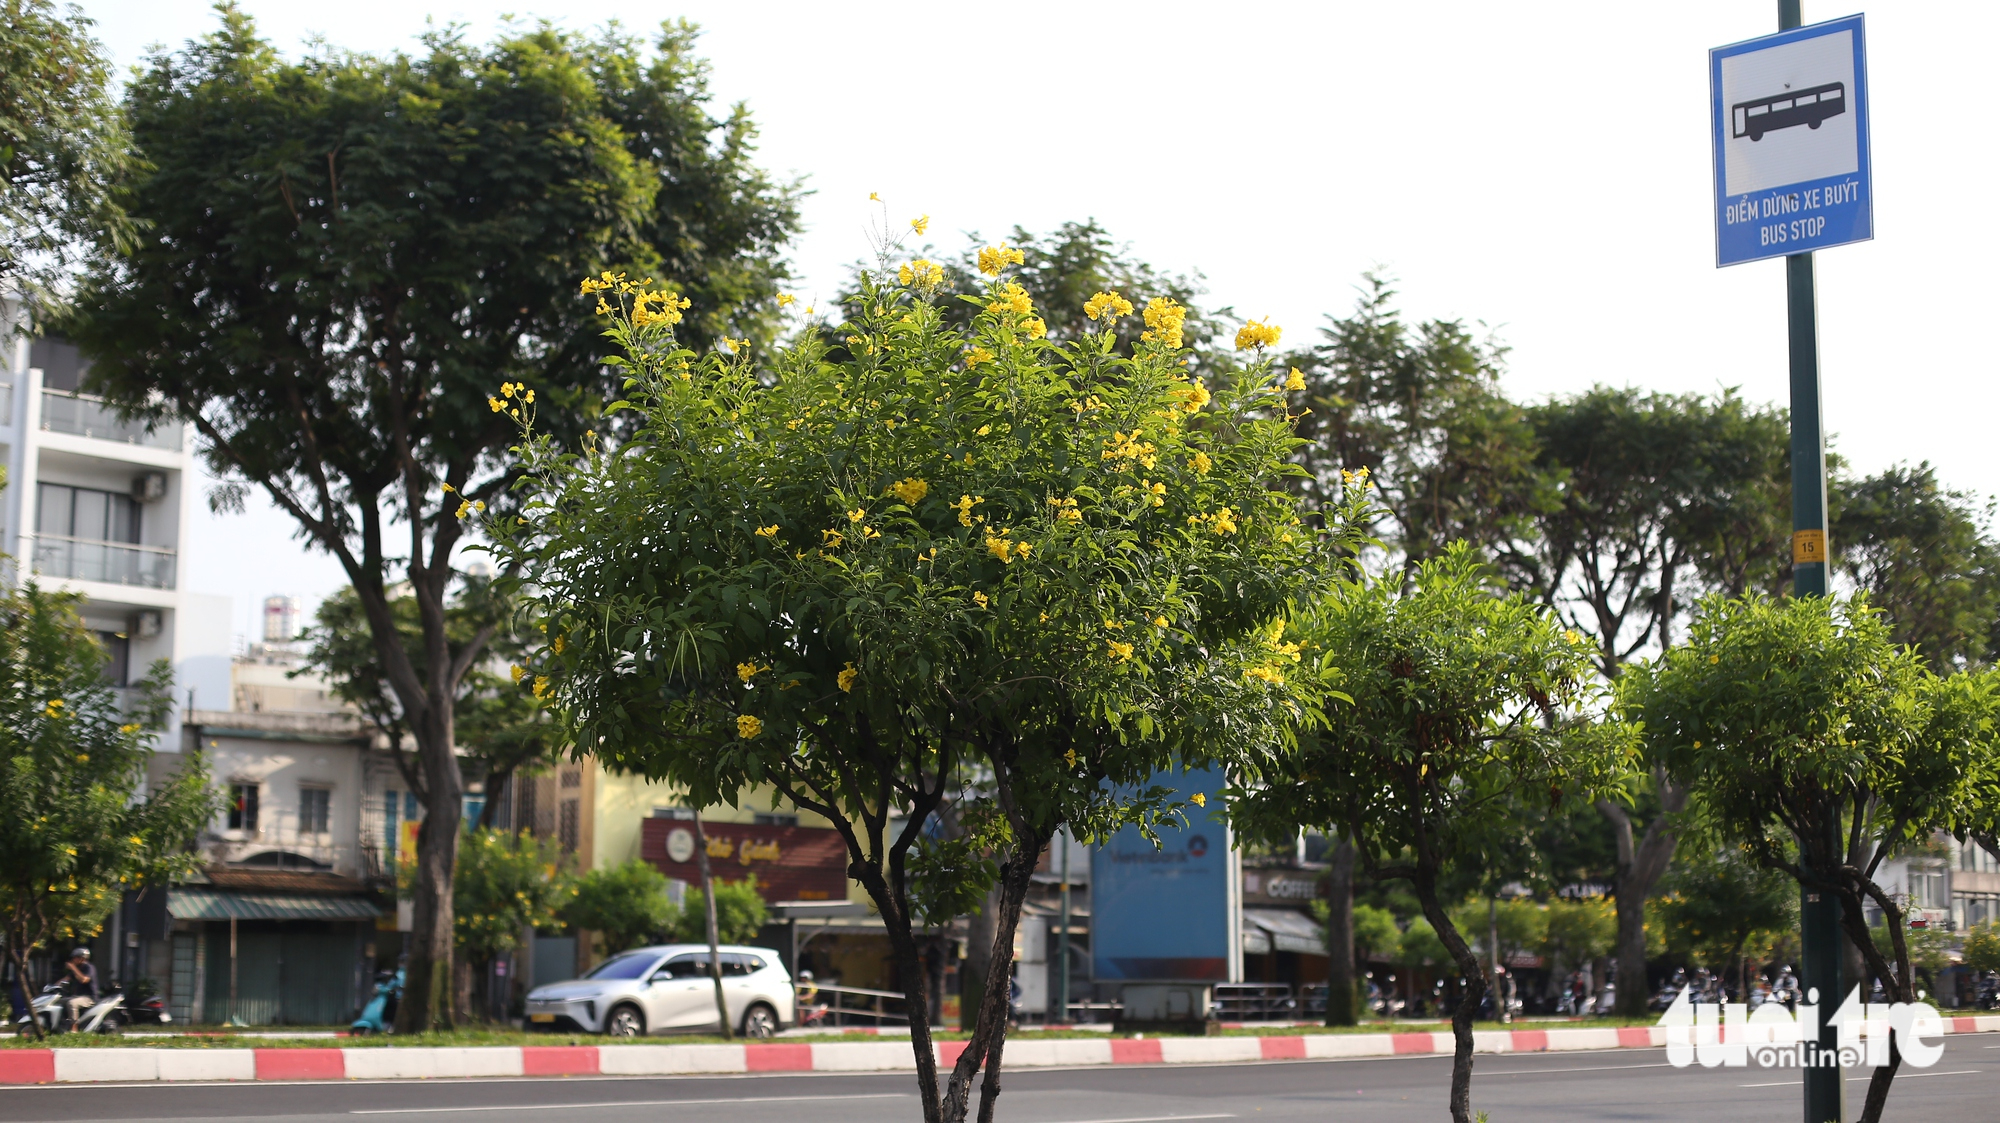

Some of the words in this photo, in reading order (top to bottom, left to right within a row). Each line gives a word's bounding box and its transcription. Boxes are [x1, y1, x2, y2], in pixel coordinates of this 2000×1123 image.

[1726, 194, 1759, 226] ĐIỂM
[1763, 191, 1800, 218] DỪNG
[1803, 188, 1821, 211] XE
[1825, 177, 1859, 207] BUÝT
[1761, 223, 1787, 246] BUS
[1791, 216, 1826, 241] STOP
[1801, 541, 1814, 553] 15
